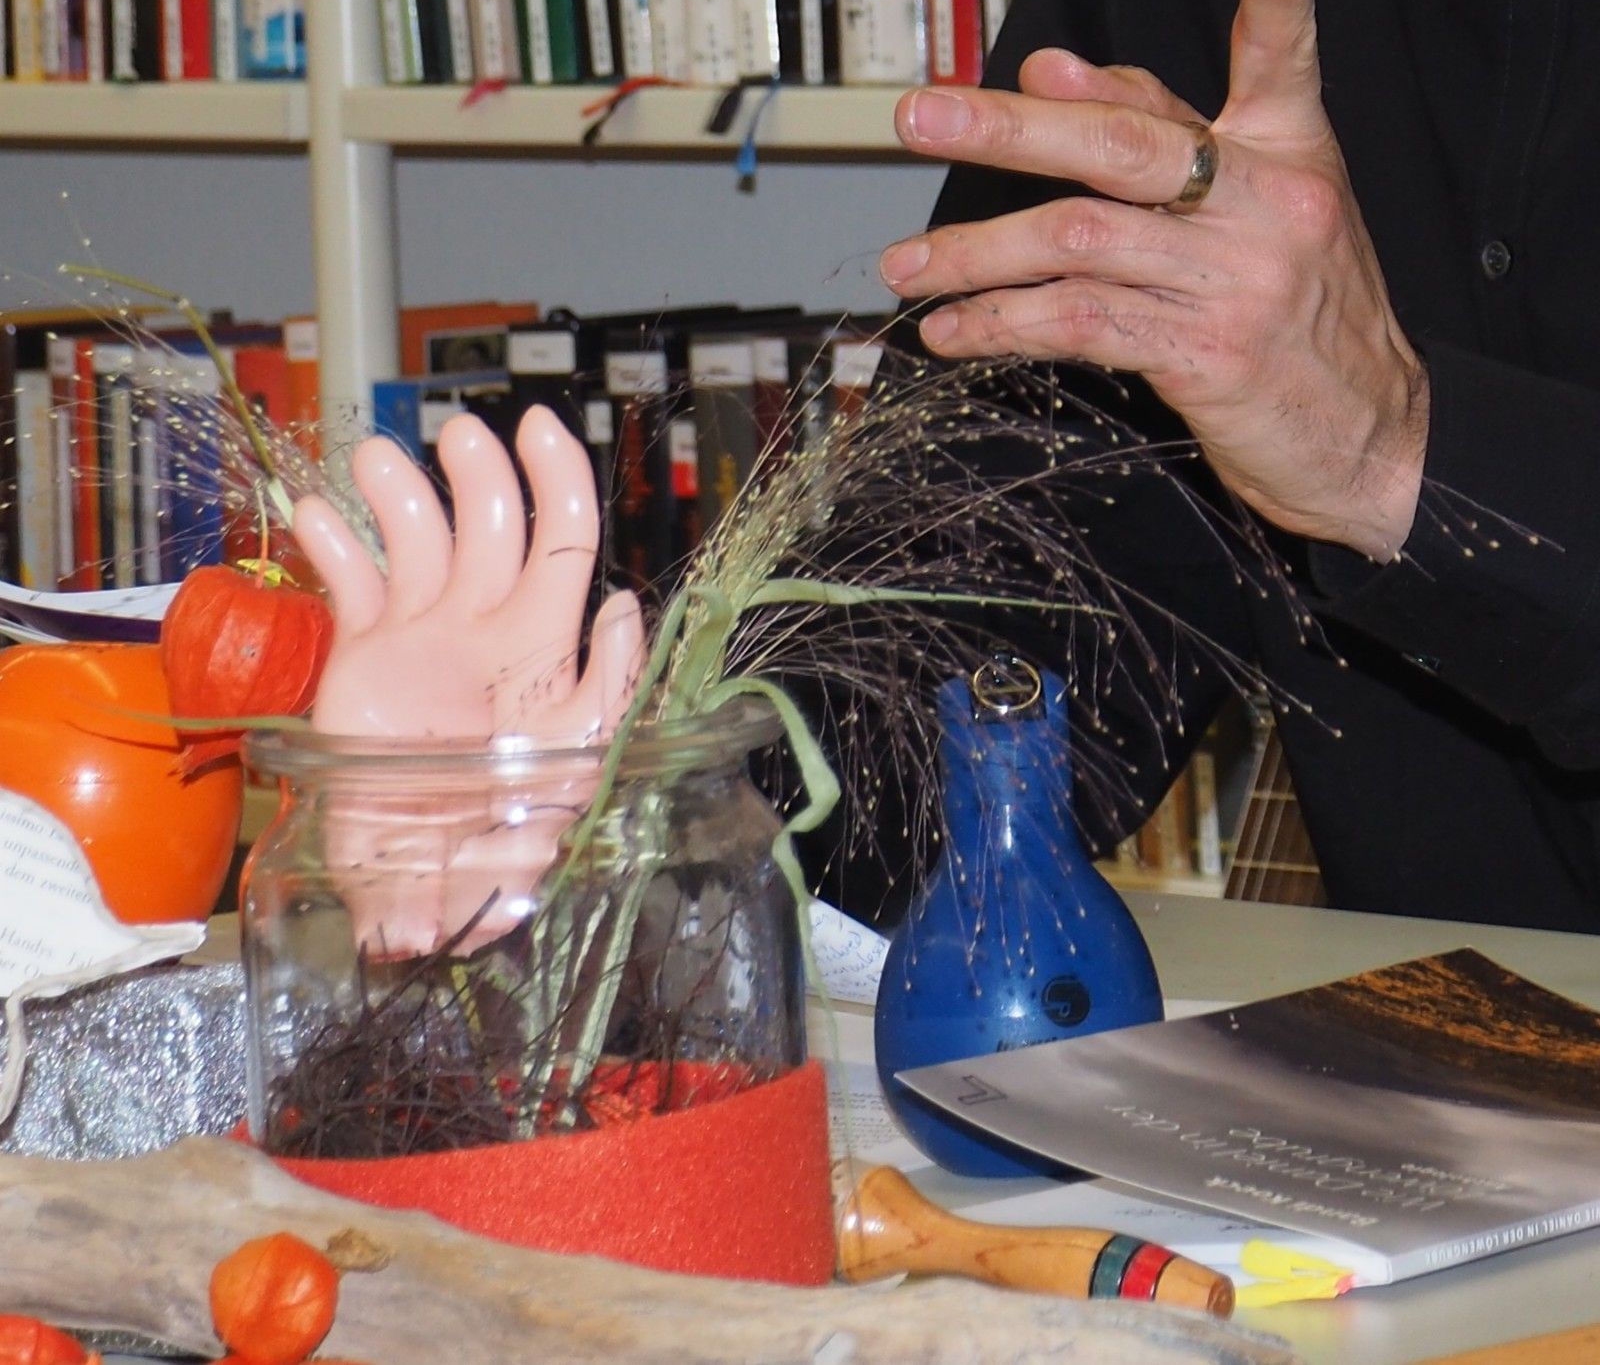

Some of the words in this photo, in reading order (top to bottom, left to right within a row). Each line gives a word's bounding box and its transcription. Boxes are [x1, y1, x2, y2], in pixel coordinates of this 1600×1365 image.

[1523, 1222, 1541, 1240] IN
[1541, 1210, 1583, 1236] DANIEL
[1499, 1226, 1525, 1247] DER
[1423, 1233, 1500, 1267] LÖWENGRUBE
